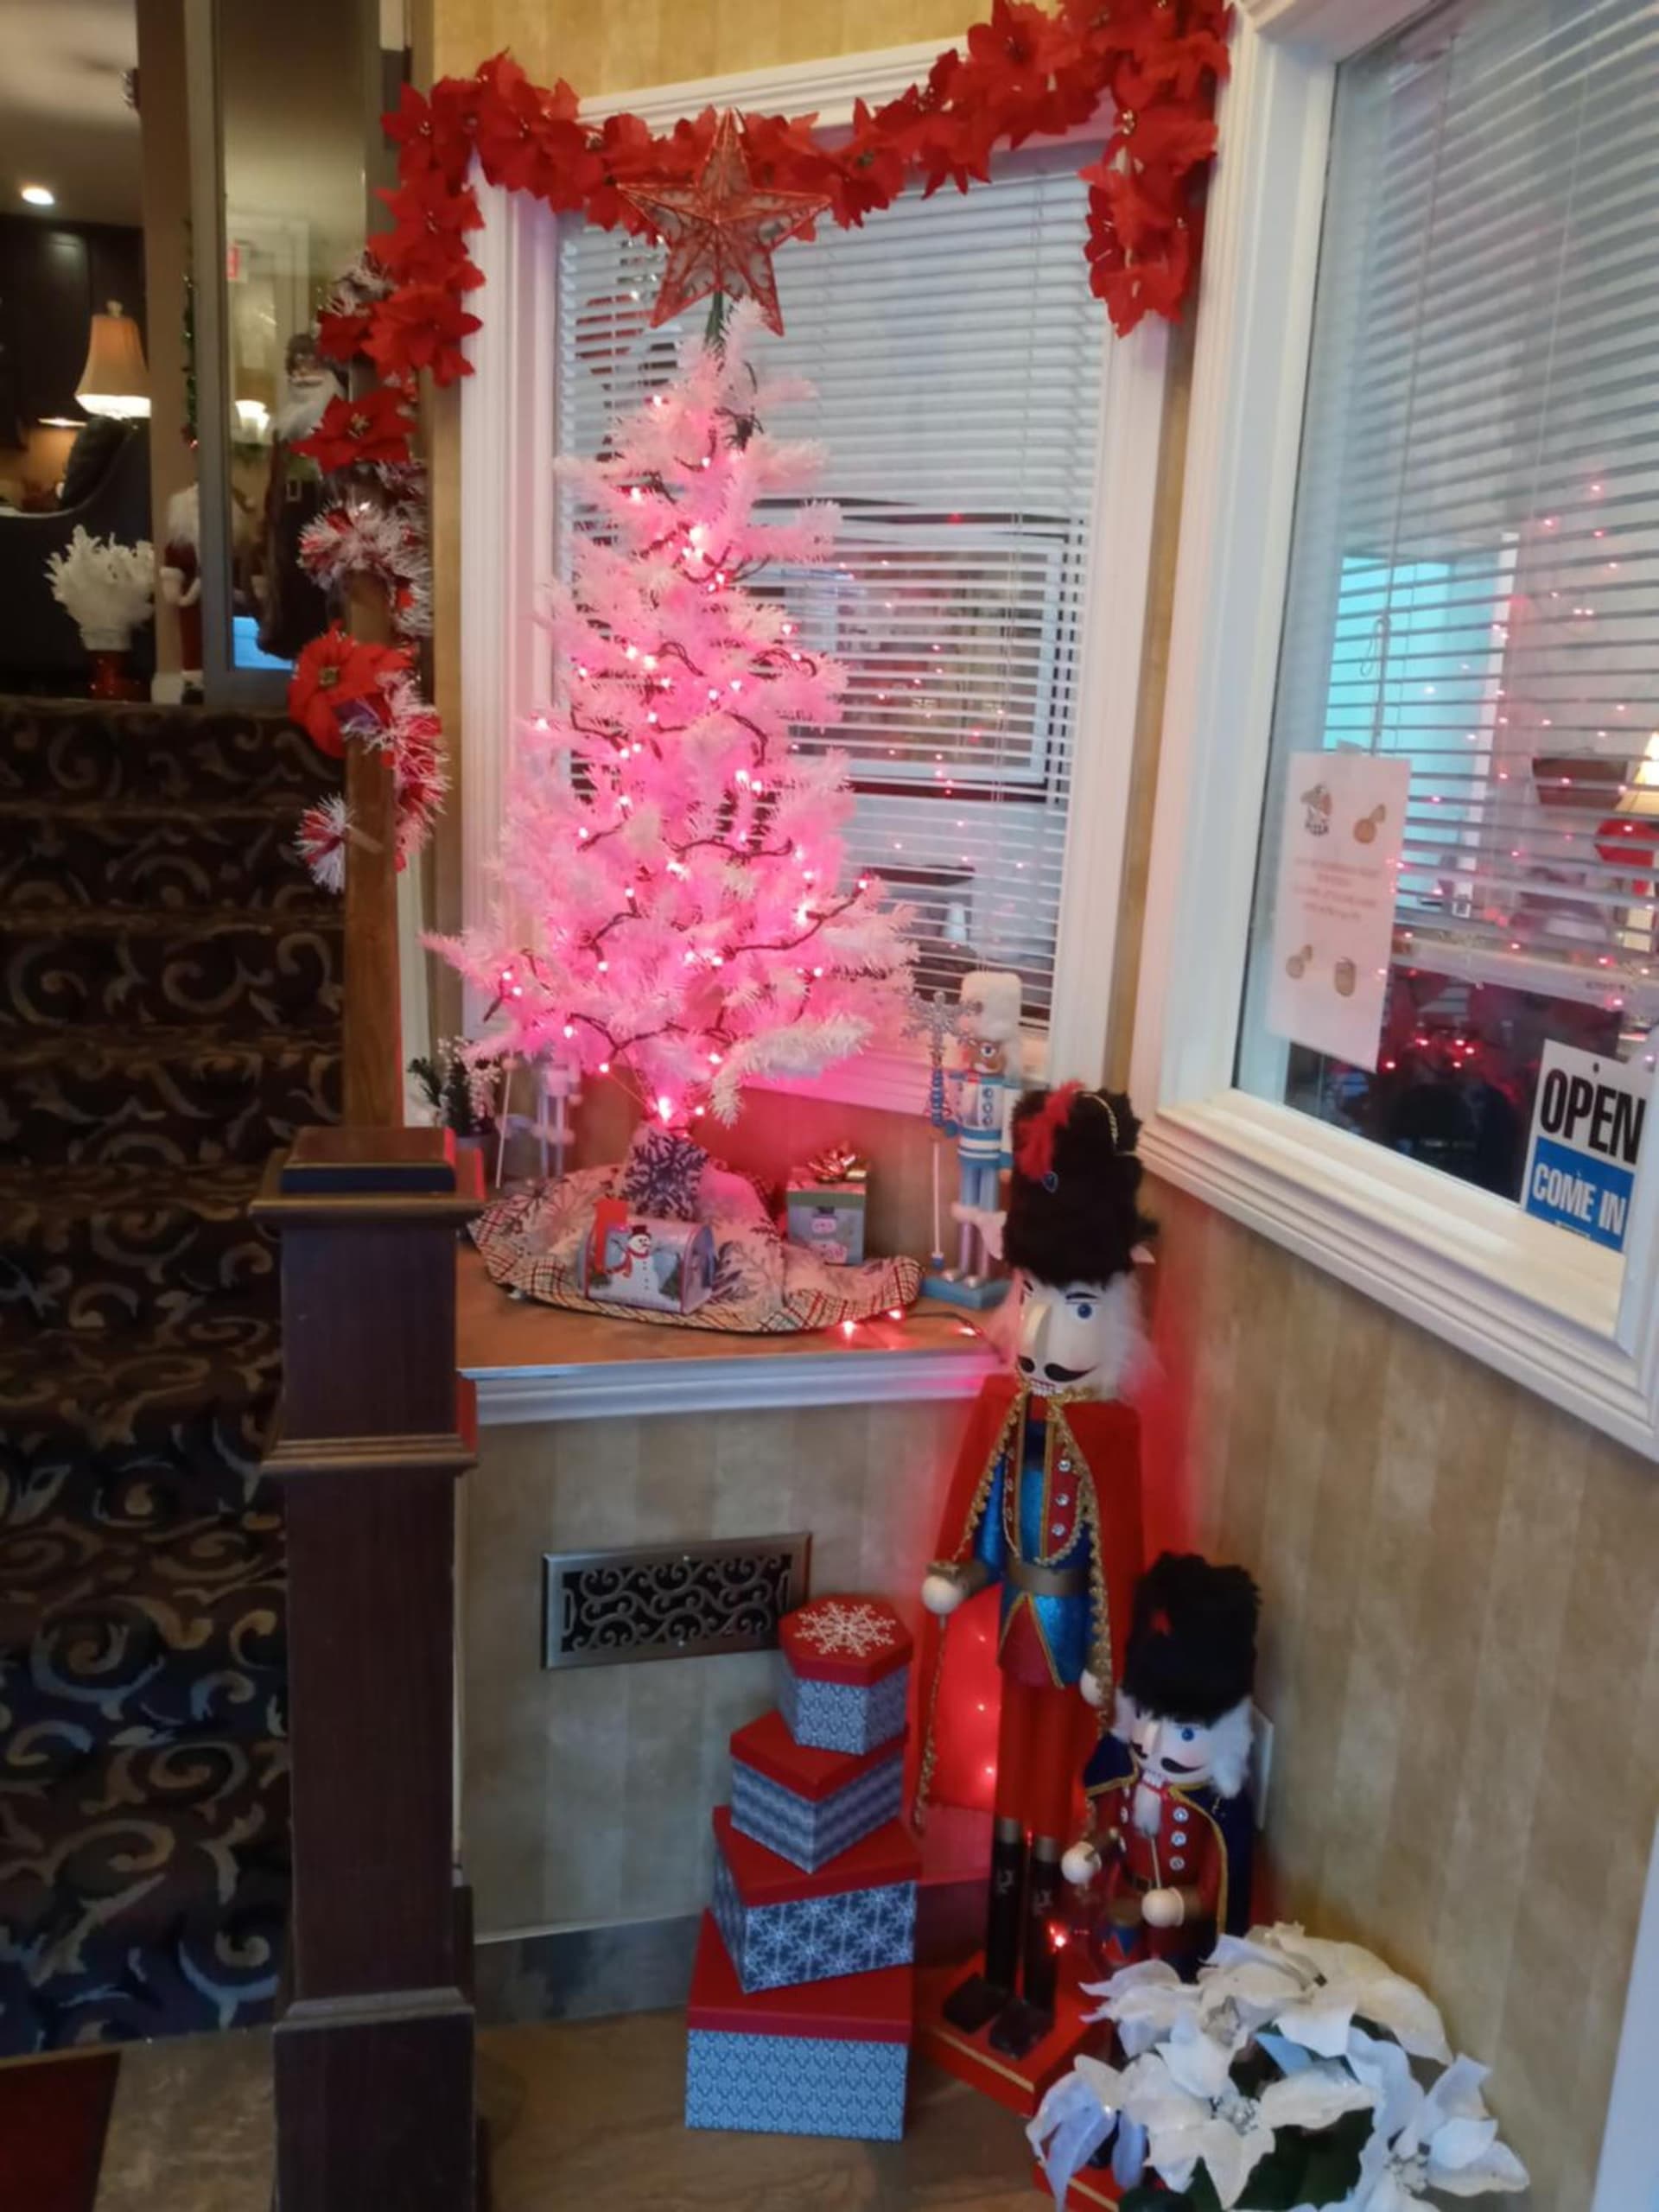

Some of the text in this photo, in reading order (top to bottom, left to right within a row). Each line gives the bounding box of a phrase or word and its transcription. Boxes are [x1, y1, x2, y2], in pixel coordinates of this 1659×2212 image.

[1541, 1069, 1645, 1164] OPEN
[1533, 1164, 1625, 1235] COME IN
